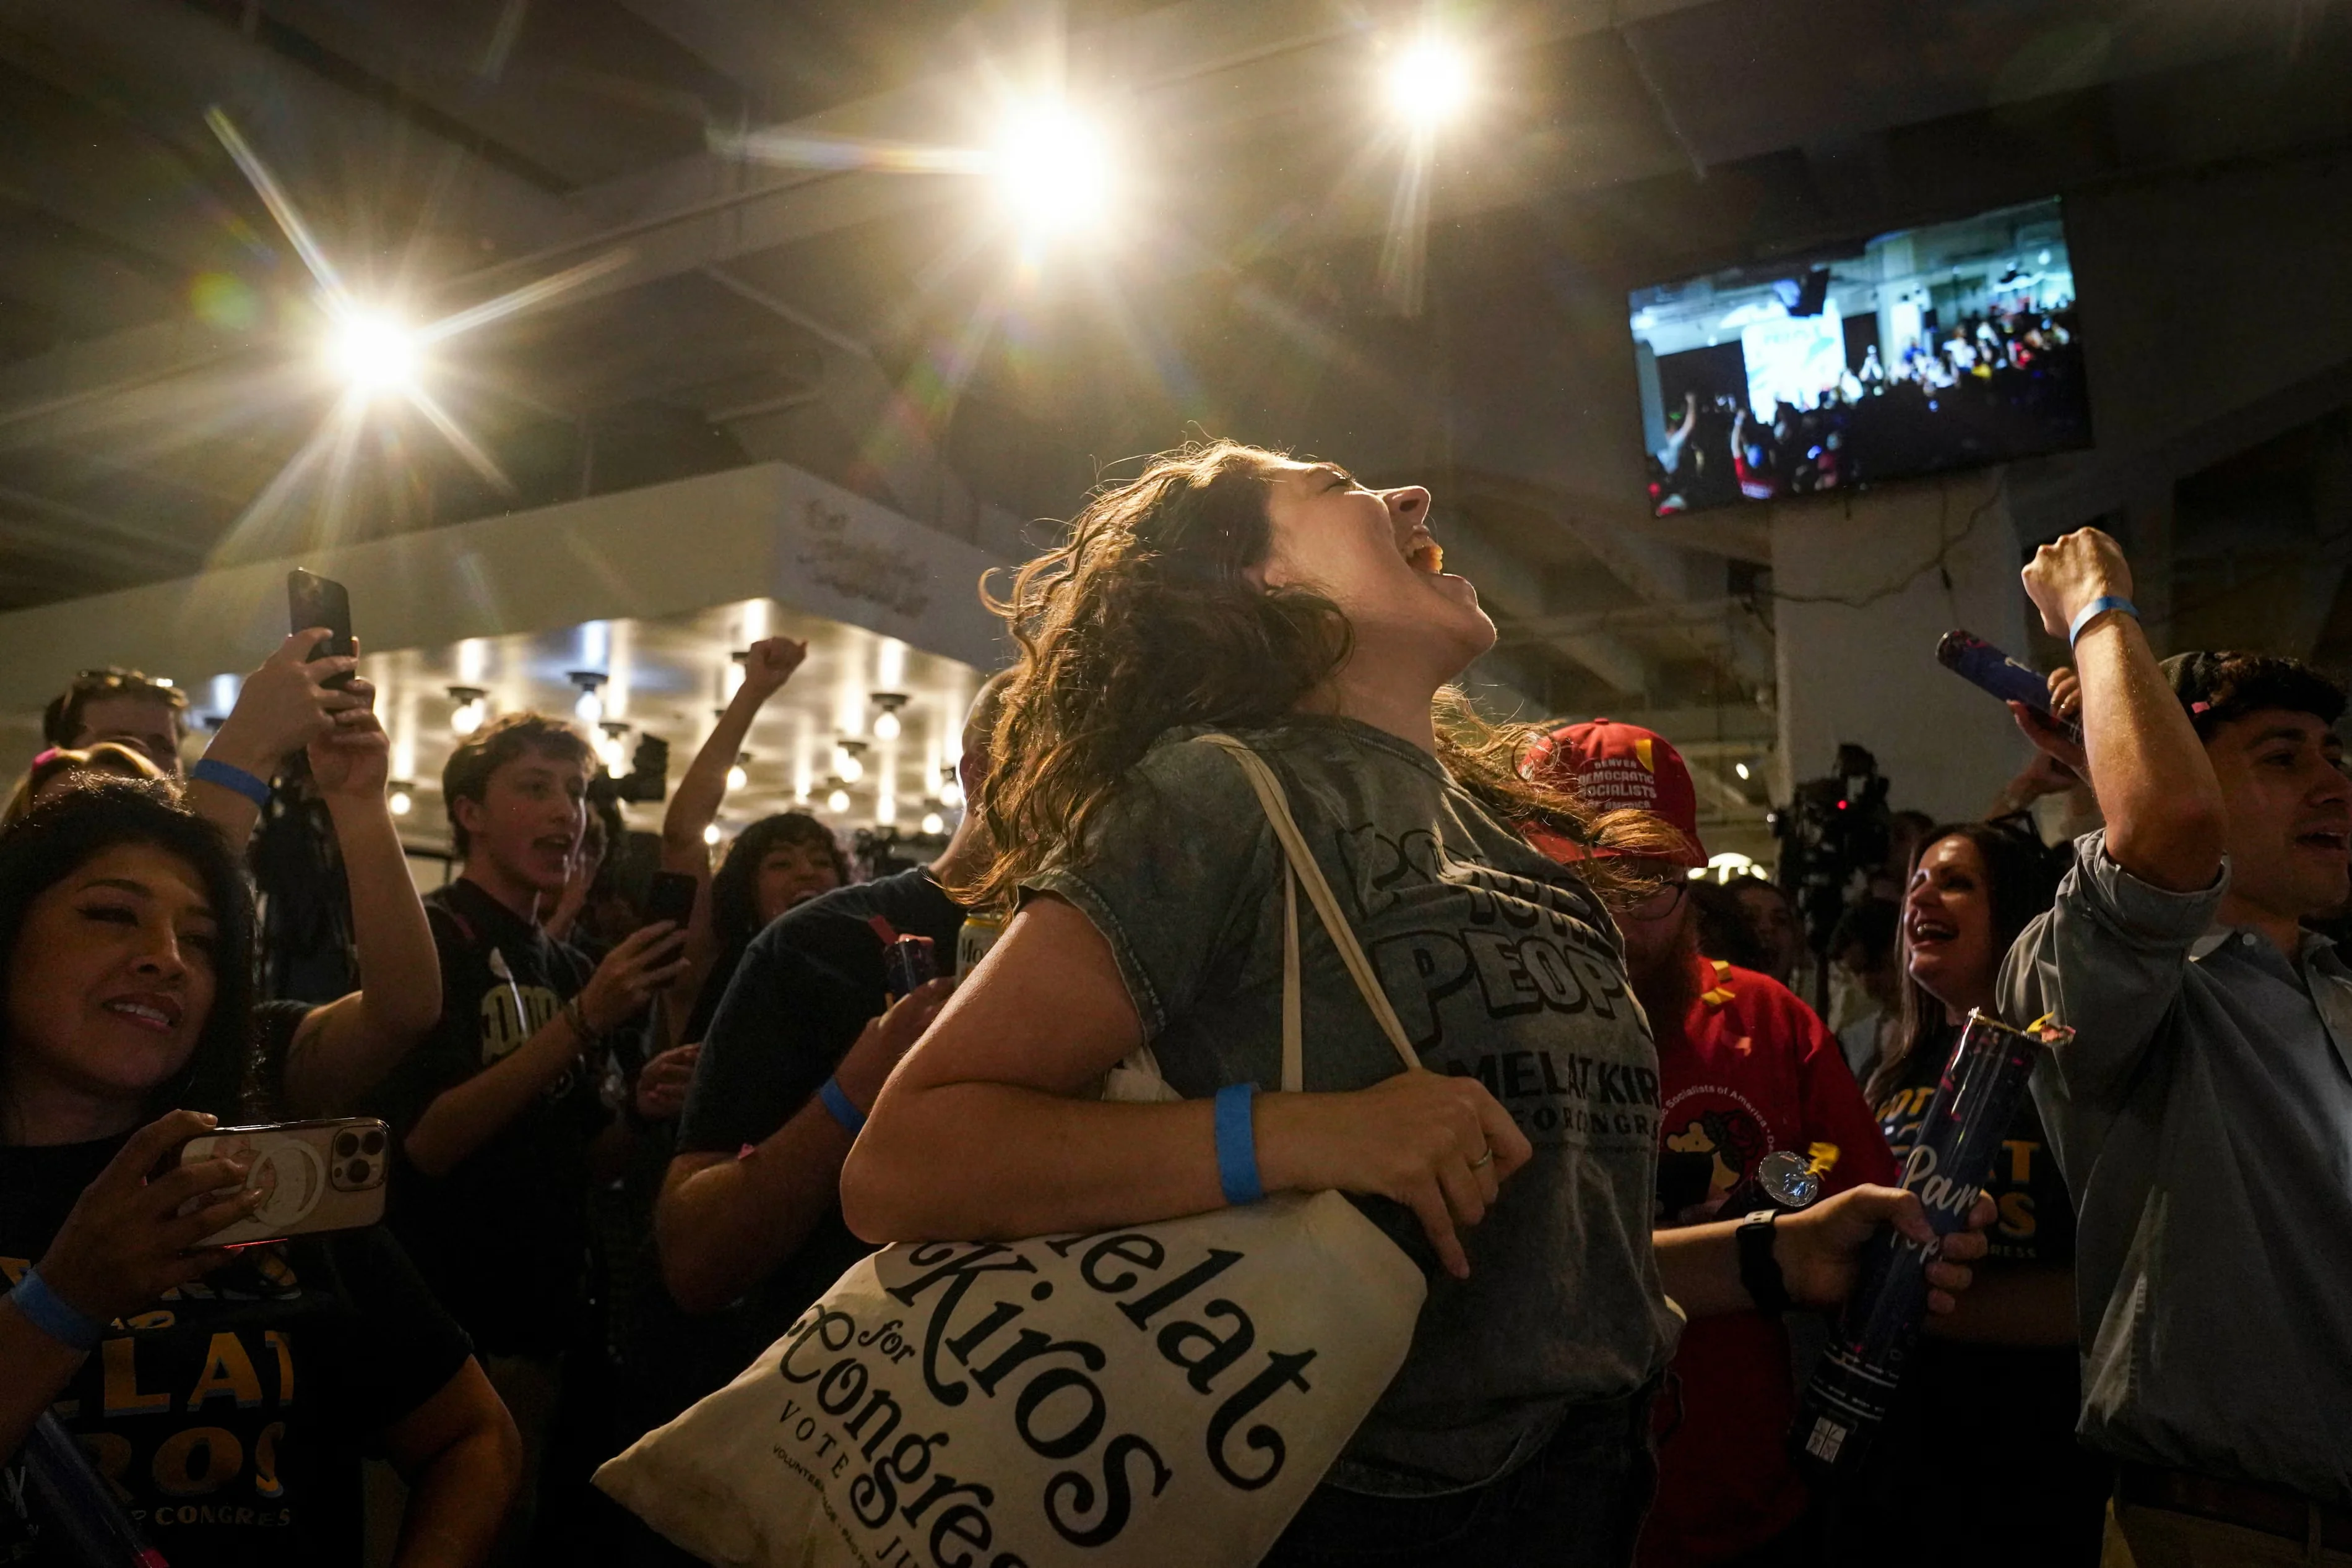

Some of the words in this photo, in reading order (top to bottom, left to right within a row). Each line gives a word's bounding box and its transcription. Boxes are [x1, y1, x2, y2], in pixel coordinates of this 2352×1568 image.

[1579, 770, 1654, 785] DEMOCRATIC
[1594, 758, 1637, 769] DENVER
[1368, 928, 1628, 1051] PEOP
[1598, 1061, 1661, 1109] KIR
[1665, 1084, 1715, 1109] Socialists
[1717, 1086, 1729, 1095] of
[1729, 1090, 1768, 1128] America
[858, 1319, 915, 1364] for
[1045, 1233, 1317, 1490] elat
[886, 1240, 1172, 1547] Kiros
[780, 1304, 1029, 1568] Congre
[780, 1400, 849, 1478] VOTE
[154, 1506, 292, 1527] CONGRES
